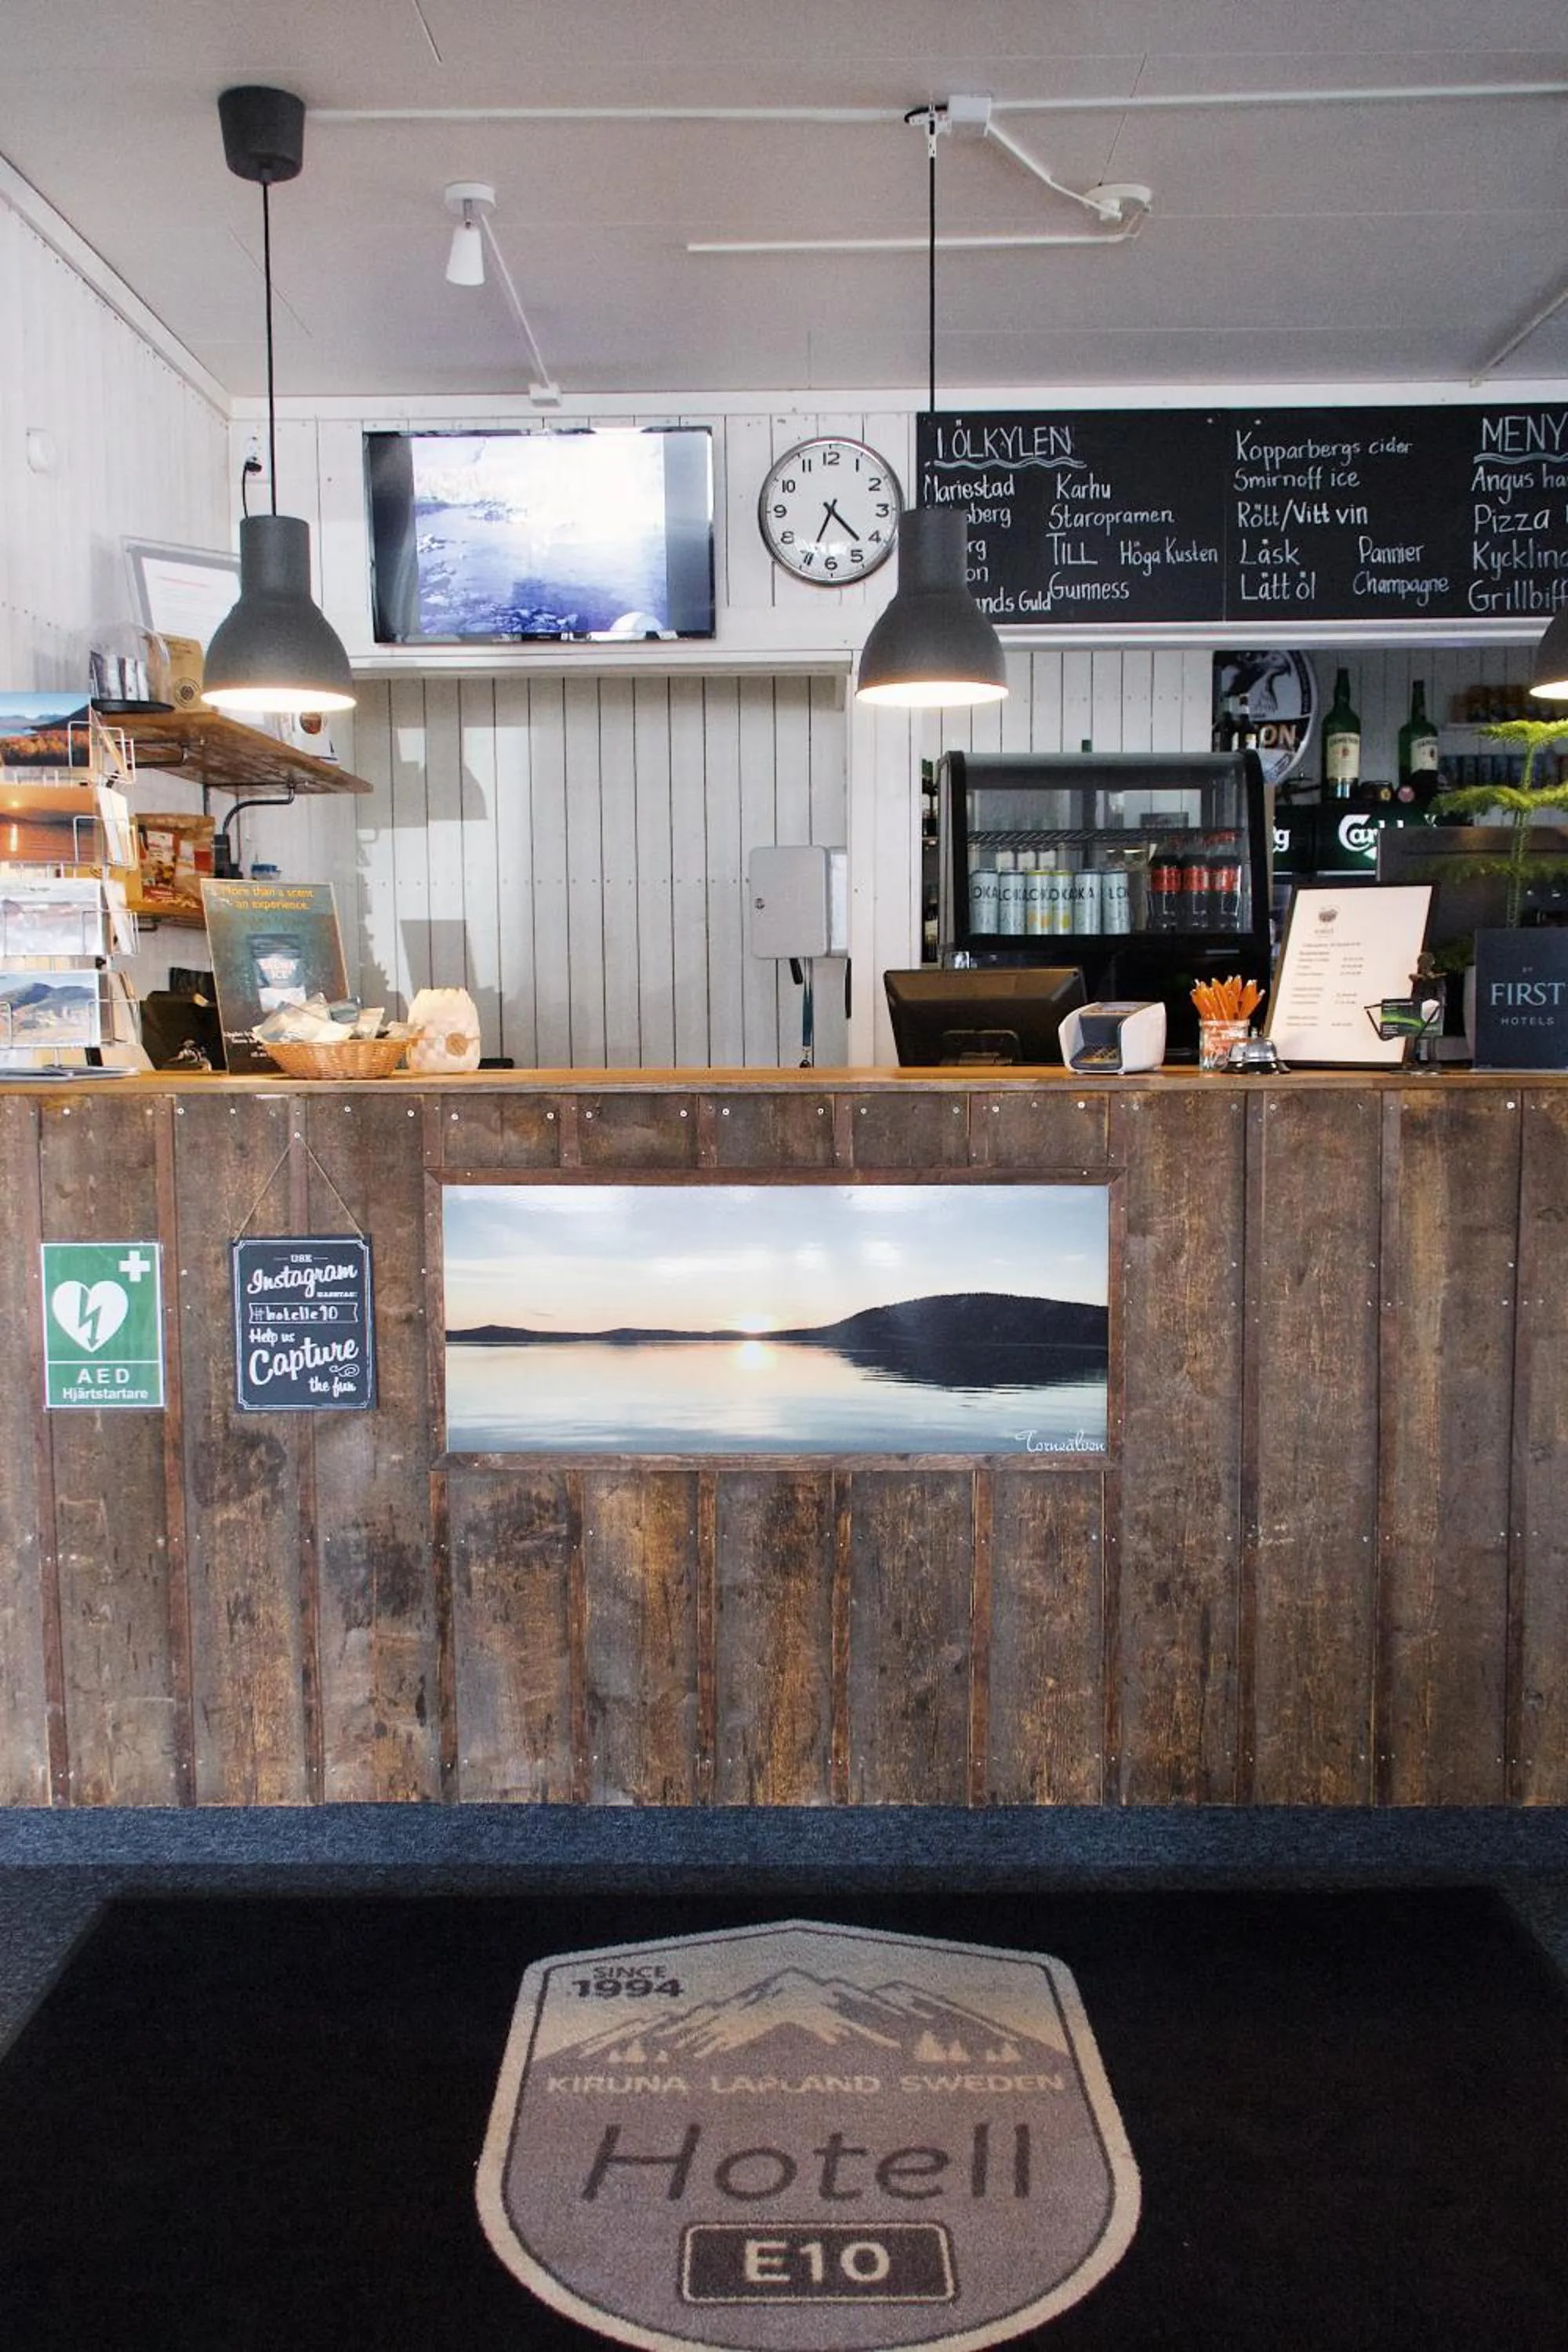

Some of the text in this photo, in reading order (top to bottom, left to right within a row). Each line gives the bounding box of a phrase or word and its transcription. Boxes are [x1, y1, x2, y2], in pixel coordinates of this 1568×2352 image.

[1483, 412, 1568, 452] MENY
[822, 452, 840, 466] 12
[1236, 430, 1414, 470] Kopparbergs cider
[802, 459, 811, 473] 11
[782, 480, 796, 493] 10
[868, 477, 882, 492] 2
[1057, 473, 1111, 500] Karhu
[1233, 466, 1360, 492] Smirnoff ice
[1471, 466, 1534, 504] Angus
[774, 504, 787, 518] 9
[875, 503, 890, 517] 3
[1049, 503, 1175, 535] Staropramen
[1336, 504, 1369, 525] vin
[1475, 504, 1550, 533] Pizza
[780, 531, 795, 545] 8
[868, 529, 882, 544] 4
[851, 549, 864, 563] 5
[1045, 532, 1098, 565] TILL
[1120, 537, 1218, 576] Höga Kusten
[824, 557, 839, 571] 6
[1352, 571, 1450, 607] Champagne
[1019, 590, 1052, 612] Guld
[1491, 982, 1566, 1006] FIRST
[1501, 1017, 1555, 1026] HOTELS
[247, 1265, 358, 1298] Instagram
[249, 1327, 296, 1347] Help us
[249, 1337, 360, 1385] Capture
[62, 1387, 149, 1402] Hjärtstartare
[308, 1376, 357, 1398] the fun
[593, 1965, 667, 1979] SINCE
[572, 1978, 684, 1998] 1994
[547, 2072, 1066, 2095] KIRUNA LAPLAND SWEDEN
[581, 2122, 1031, 2201] Hotell
[743, 2239, 891, 2284] E10
